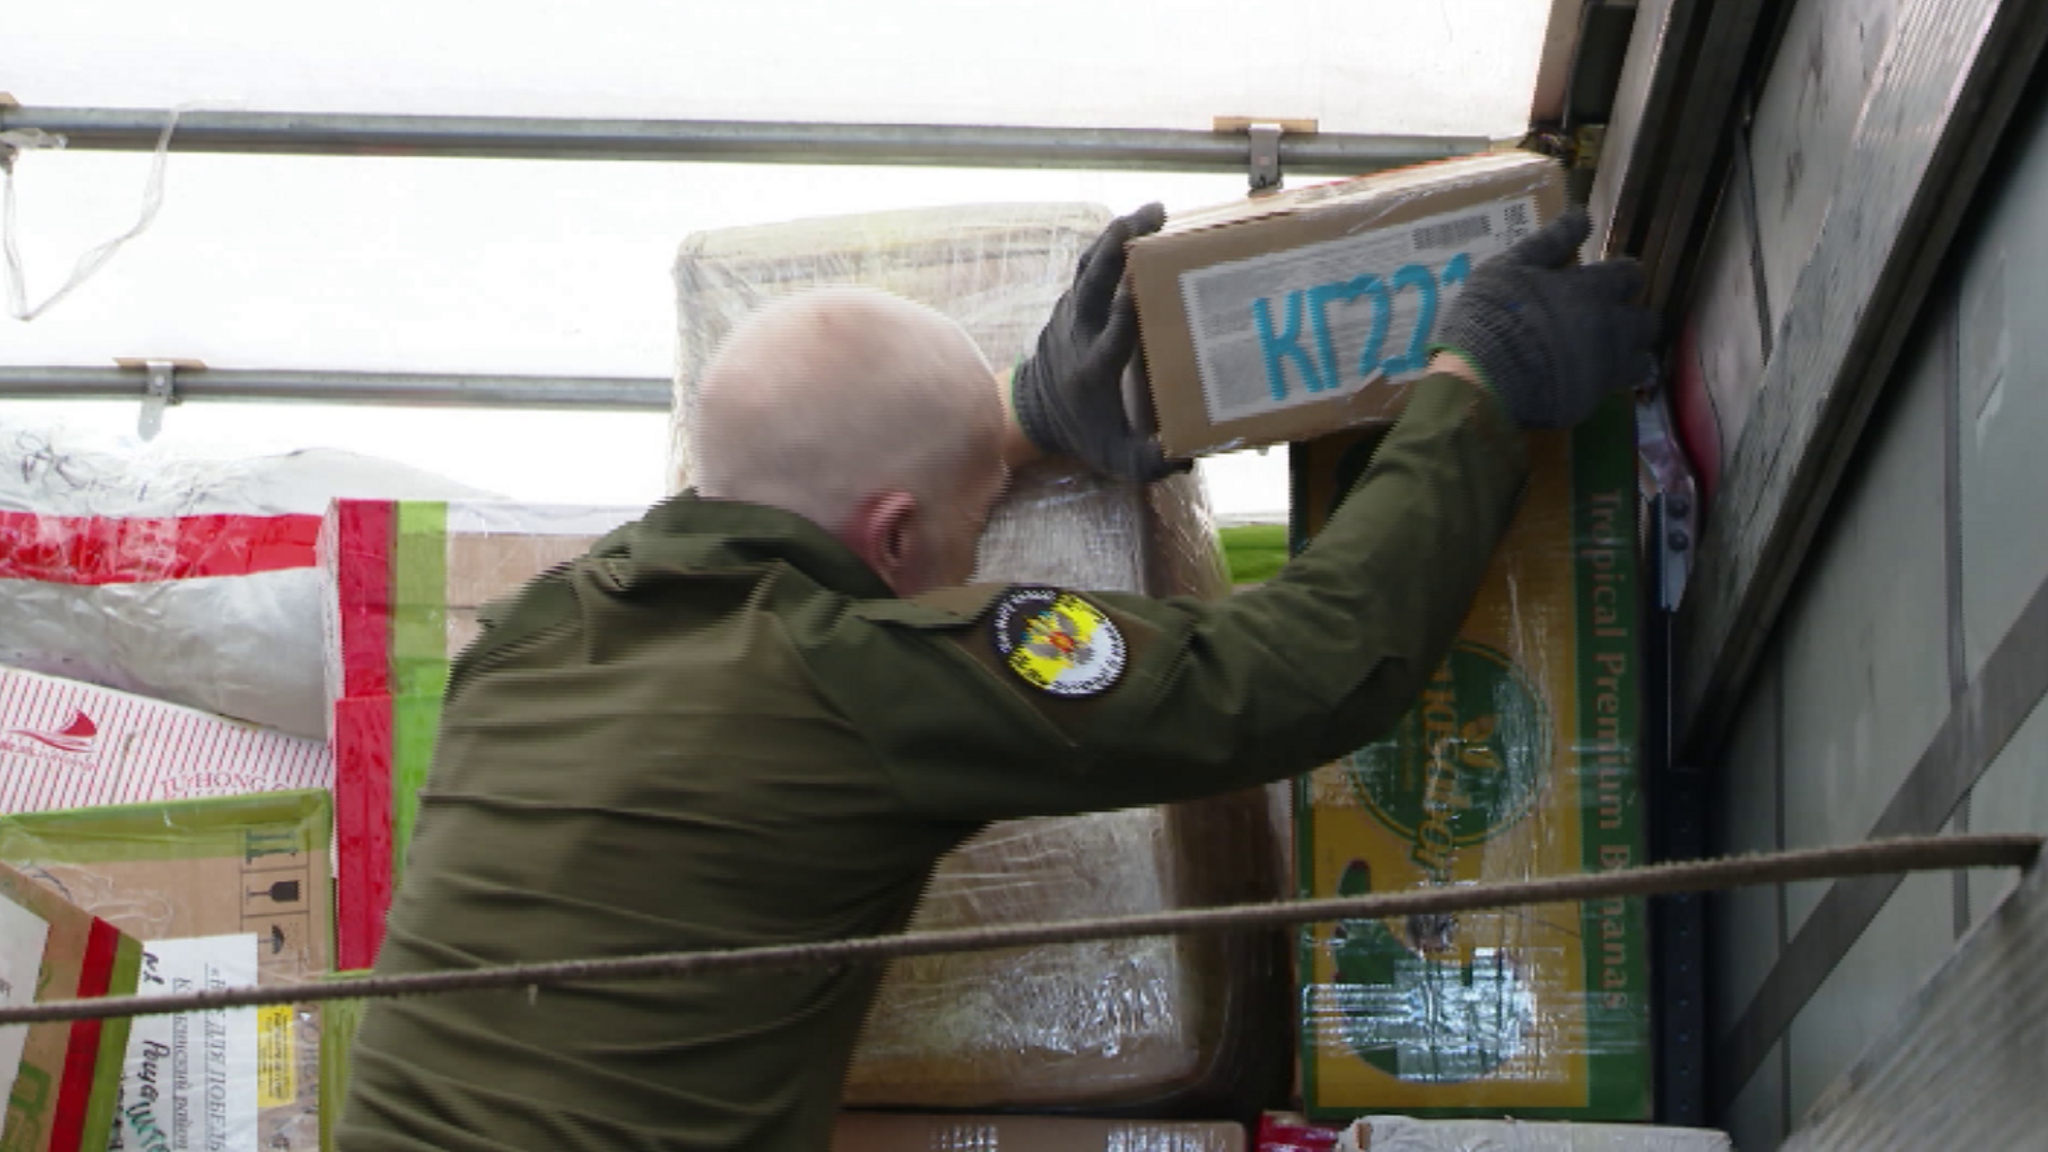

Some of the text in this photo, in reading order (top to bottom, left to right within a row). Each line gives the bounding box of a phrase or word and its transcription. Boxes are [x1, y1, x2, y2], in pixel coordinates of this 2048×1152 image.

[1582, 488, 1632, 1009] Tropical Premium Bnanas
[172, 1095, 194, 1150] район
